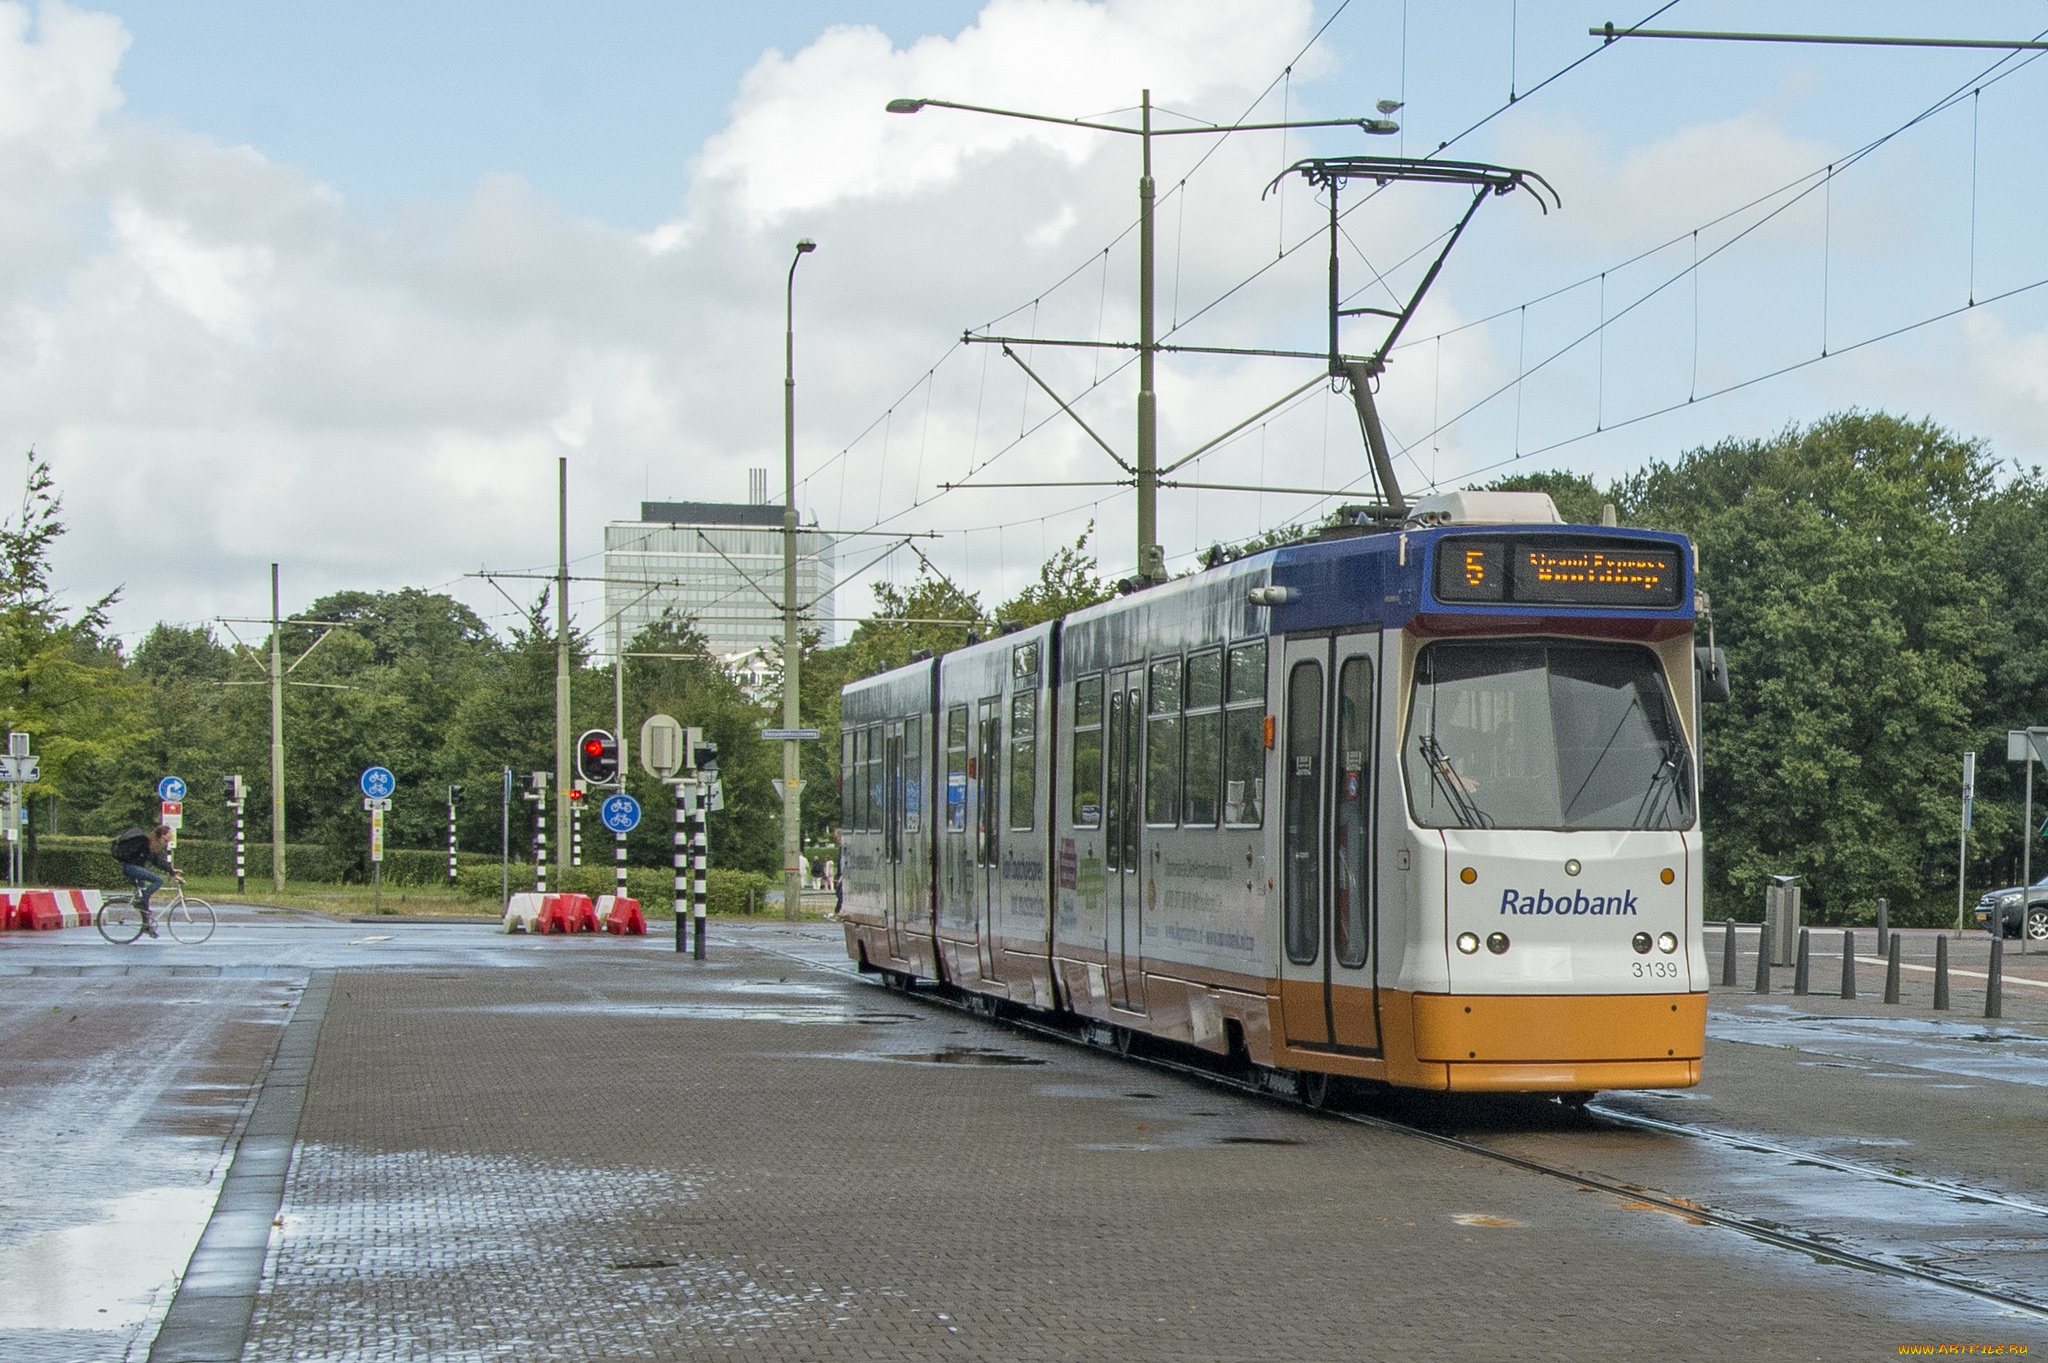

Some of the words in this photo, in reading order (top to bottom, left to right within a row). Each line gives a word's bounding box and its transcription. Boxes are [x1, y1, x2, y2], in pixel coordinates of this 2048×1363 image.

[1465, 550, 1485, 585] 5
[1500, 888, 1639, 915] Rabobank
[1632, 961, 1678, 978] 3139
